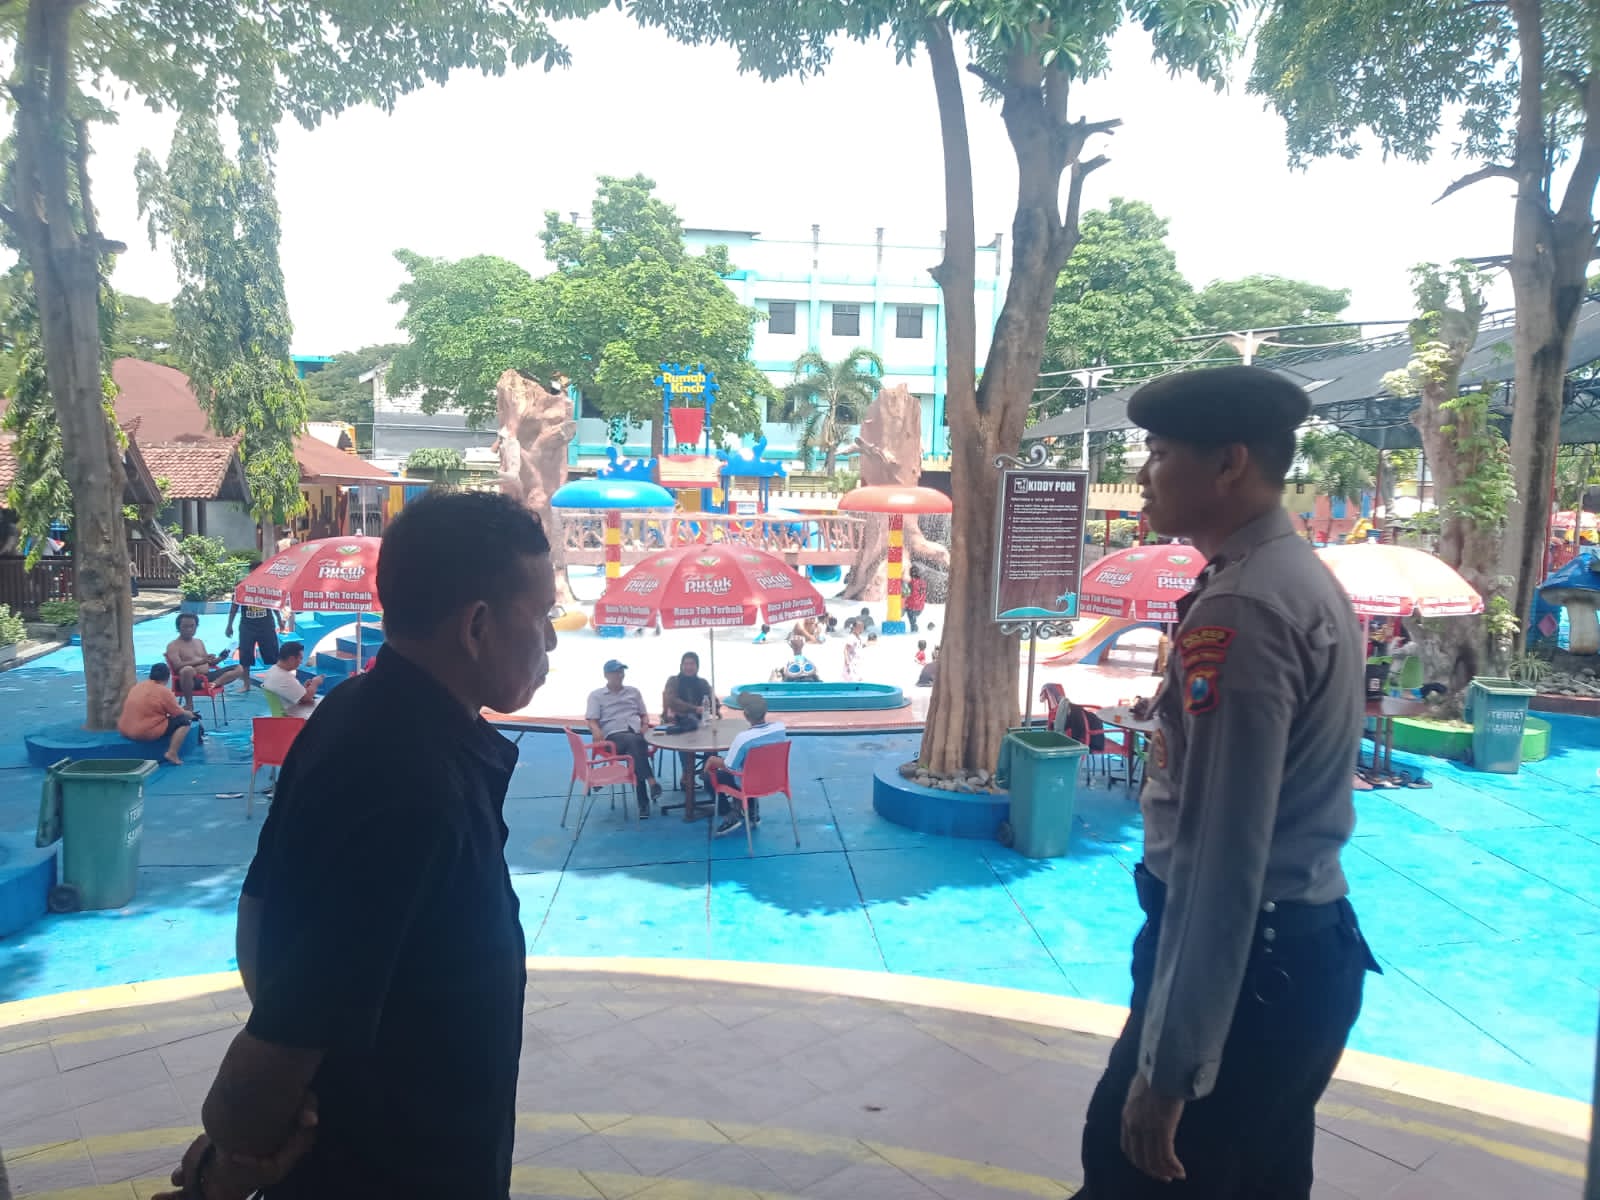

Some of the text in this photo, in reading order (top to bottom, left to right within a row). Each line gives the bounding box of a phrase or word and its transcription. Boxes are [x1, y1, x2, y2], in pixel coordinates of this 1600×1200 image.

[664, 372, 705, 383] Rumah
[671, 383, 704, 393] Kincir
[1028, 481, 1076, 492] KIDDY POOL
